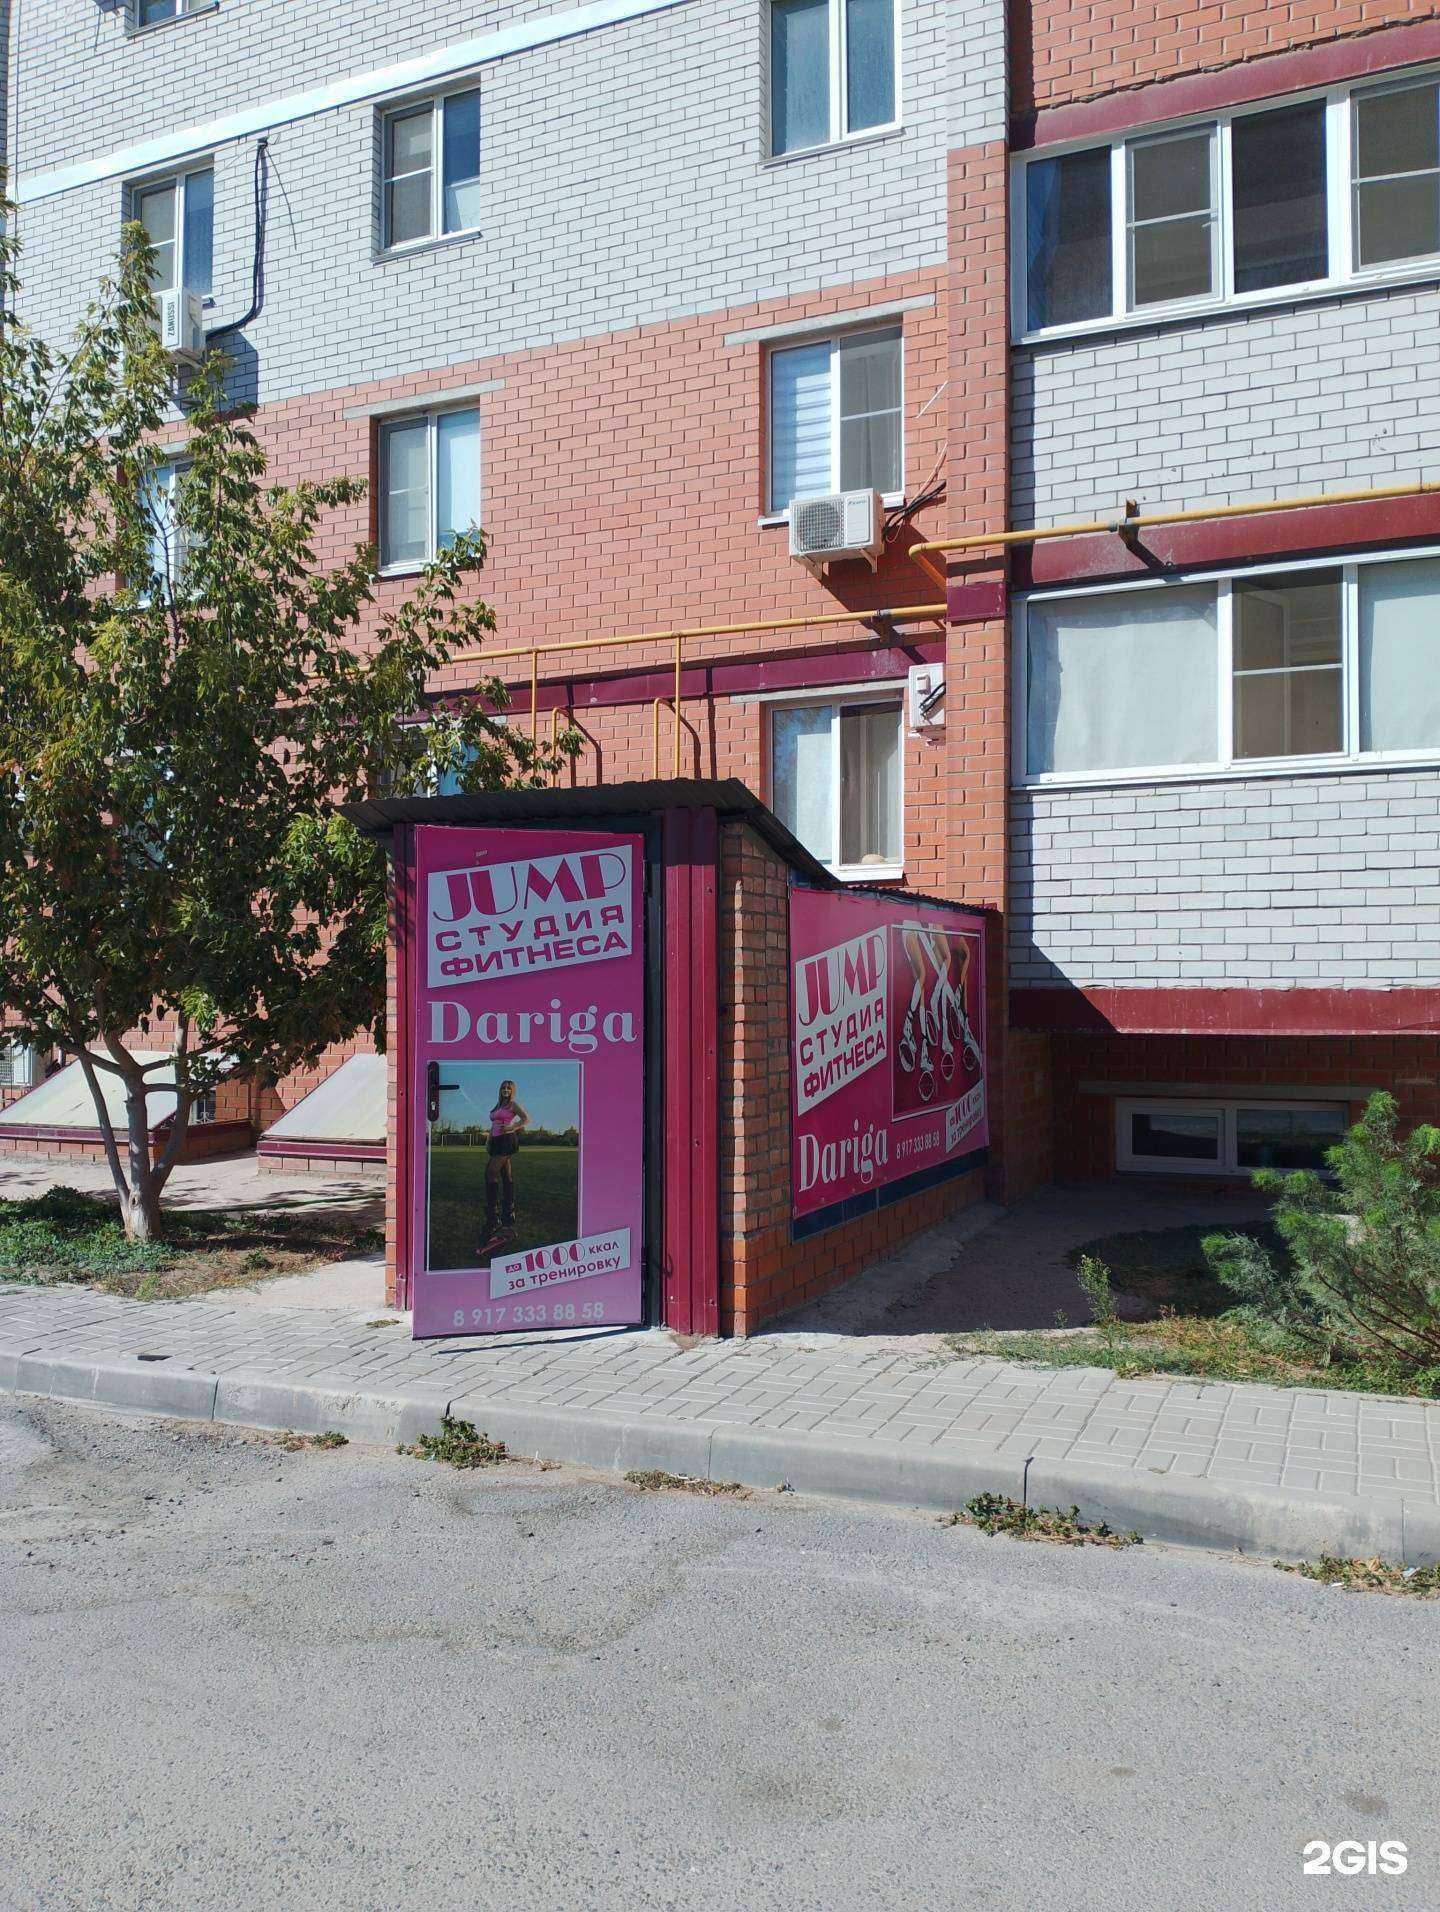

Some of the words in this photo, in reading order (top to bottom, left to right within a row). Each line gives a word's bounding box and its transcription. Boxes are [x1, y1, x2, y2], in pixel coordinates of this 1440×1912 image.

[167, 301, 175, 337] ZANUSSI
[433, 853, 626, 922] JUMP
[435, 904, 625, 952] СТУДИЯ
[440, 931, 628, 977] ФИТНЕСА
[799, 934, 885, 1026] JUMP
[427, 998, 638, 1053] Dariga
[800, 997, 884, 1066] СТУДИЯ
[803, 1029, 886, 1097] ФИТНЕСА
[798, 1118, 889, 1192] Dariga
[896, 1143, 901, 1159] 8
[902, 1138, 912, 1158] 917
[508, 1277, 526, 1291] за
[530, 1255, 621, 1286] тренировку
[522, 1242, 586, 1273] 1000
[588, 1240, 620, 1255] ккал
[453, 1308, 465, 1327] 8
[472, 1307, 506, 1326] 917
[513, 1305, 547, 1323] 333
[553, 1303, 576, 1321] 88
[582, 1302, 605, 1320] 58
